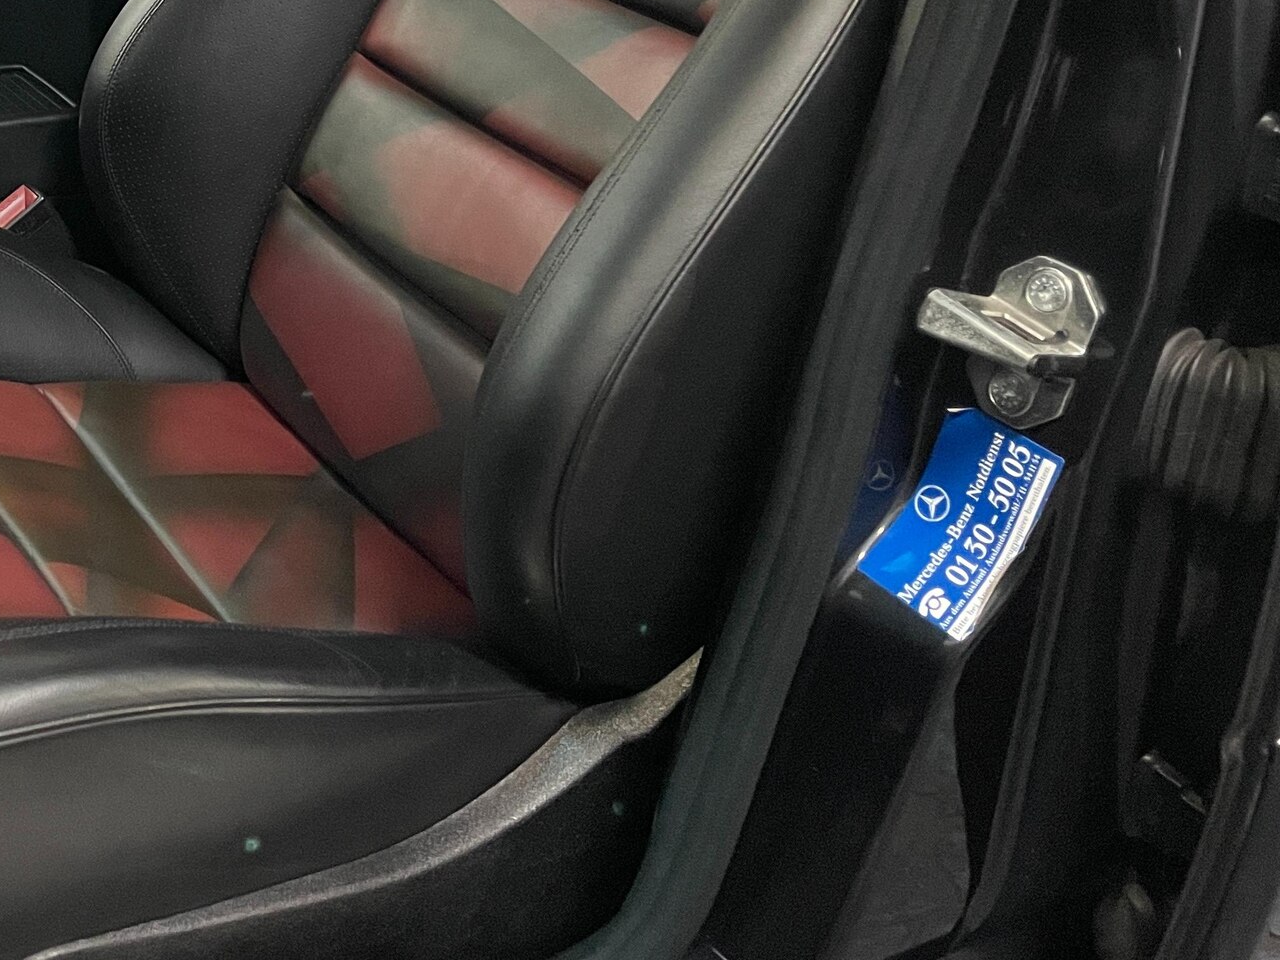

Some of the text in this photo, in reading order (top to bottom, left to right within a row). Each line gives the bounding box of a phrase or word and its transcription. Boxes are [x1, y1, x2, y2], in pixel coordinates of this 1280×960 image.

[896, 432, 1004, 604] Mercedes-Benz Notdienst
[939, 615, 953, 629] Aus
[950, 598, 966, 616] dem
[950, 614, 970, 636] Bitte
